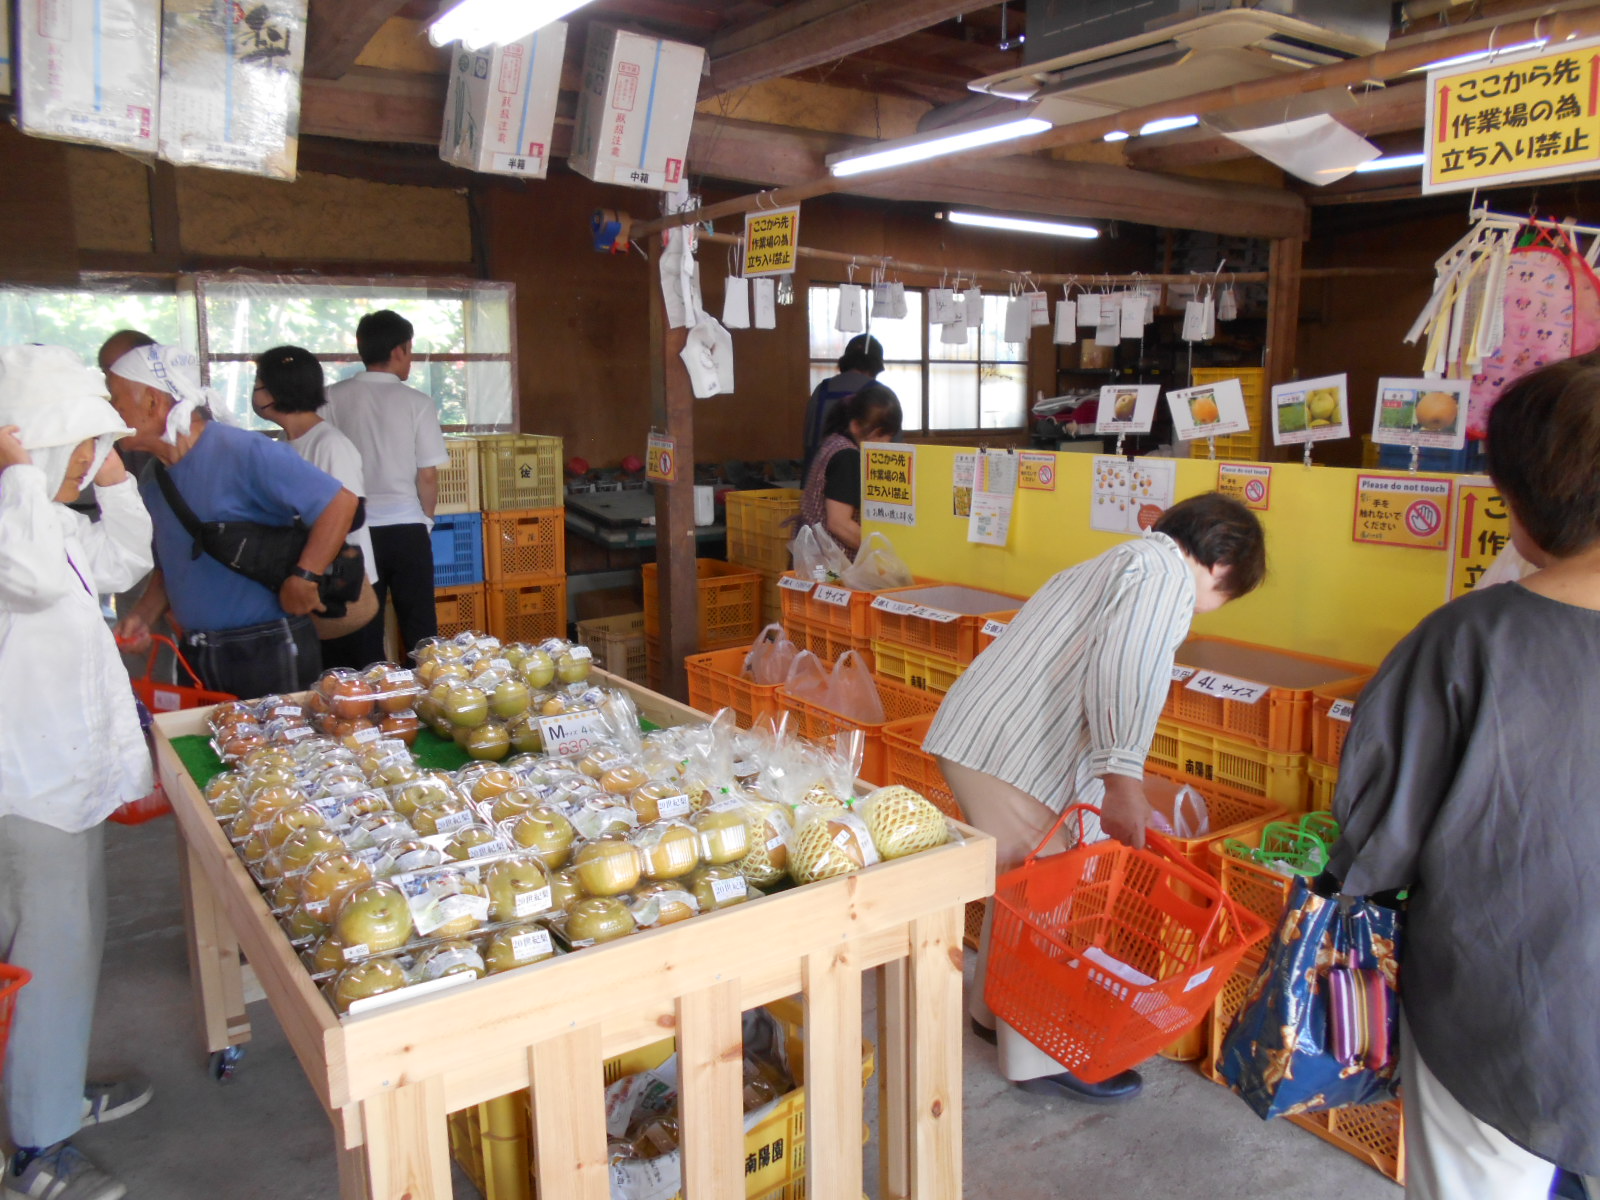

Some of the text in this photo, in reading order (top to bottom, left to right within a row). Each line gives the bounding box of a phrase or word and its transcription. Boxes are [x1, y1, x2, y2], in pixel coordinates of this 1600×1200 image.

[1457, 58, 1581, 102] ここから先
[1452, 93, 1582, 139] 作業場の為
[1440, 127, 1590, 173] 立ち入り禁止
[630, 171, 650, 184] 中箱
[753, 215, 789, 233] ここから先
[751, 235, 789, 251] 作業場の為
[747, 251, 790, 268] 立ち入り禁止
[871, 452, 906, 467] ここから先
[870, 468, 907, 484] 作業場の為
[867, 485, 909, 501] 立ち入り禁止
[1362, 480, 1446, 493] Please do not touch
[1372, 499, 1389, 508] 手を
[1359, 509, 1402, 520] 触れないで
[1364, 520, 1396, 531] ください
[1198, 676, 1258, 698] 4L サイズ
[548, 725, 565, 740] M
[745, 1138, 784, 1178] 南陽園
